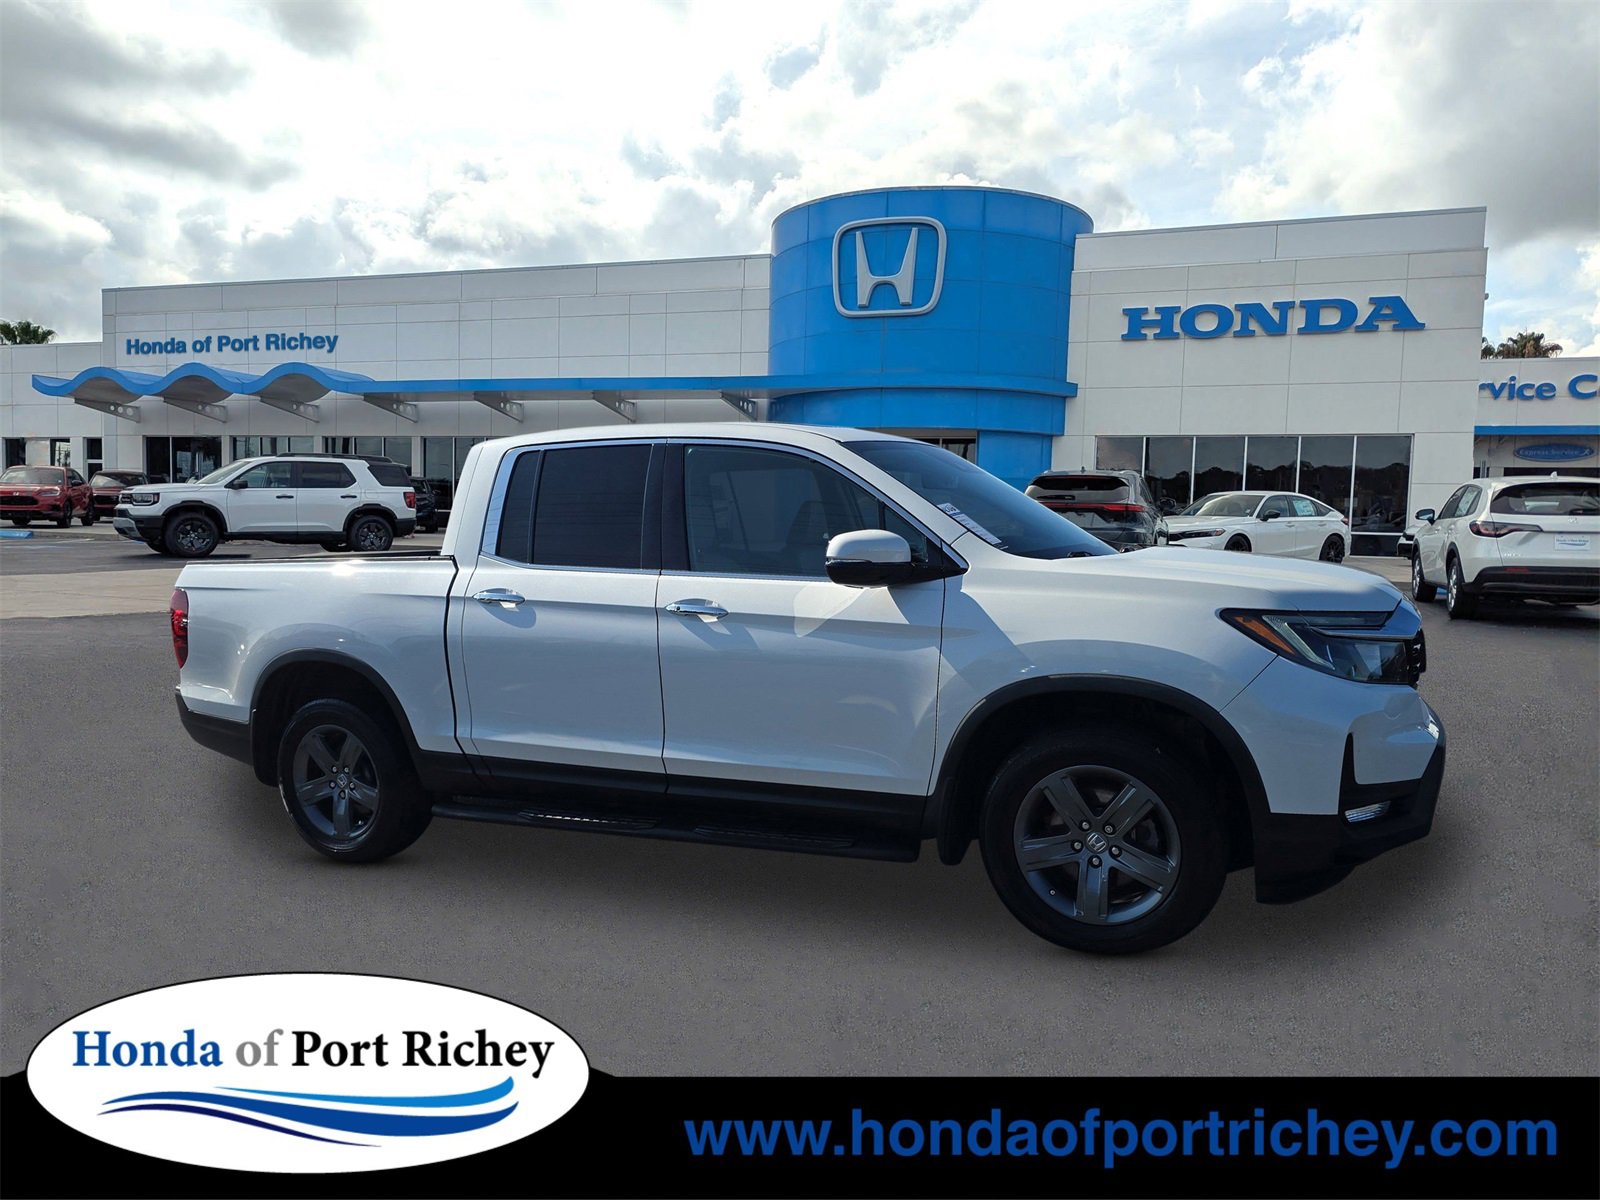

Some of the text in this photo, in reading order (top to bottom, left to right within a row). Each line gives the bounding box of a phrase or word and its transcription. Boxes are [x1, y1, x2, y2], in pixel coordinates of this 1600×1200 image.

[1120, 295, 1426, 341] HONDA
[126, 332, 339, 355] Honda of Port Richey
[1567, 373, 1600, 400] C
